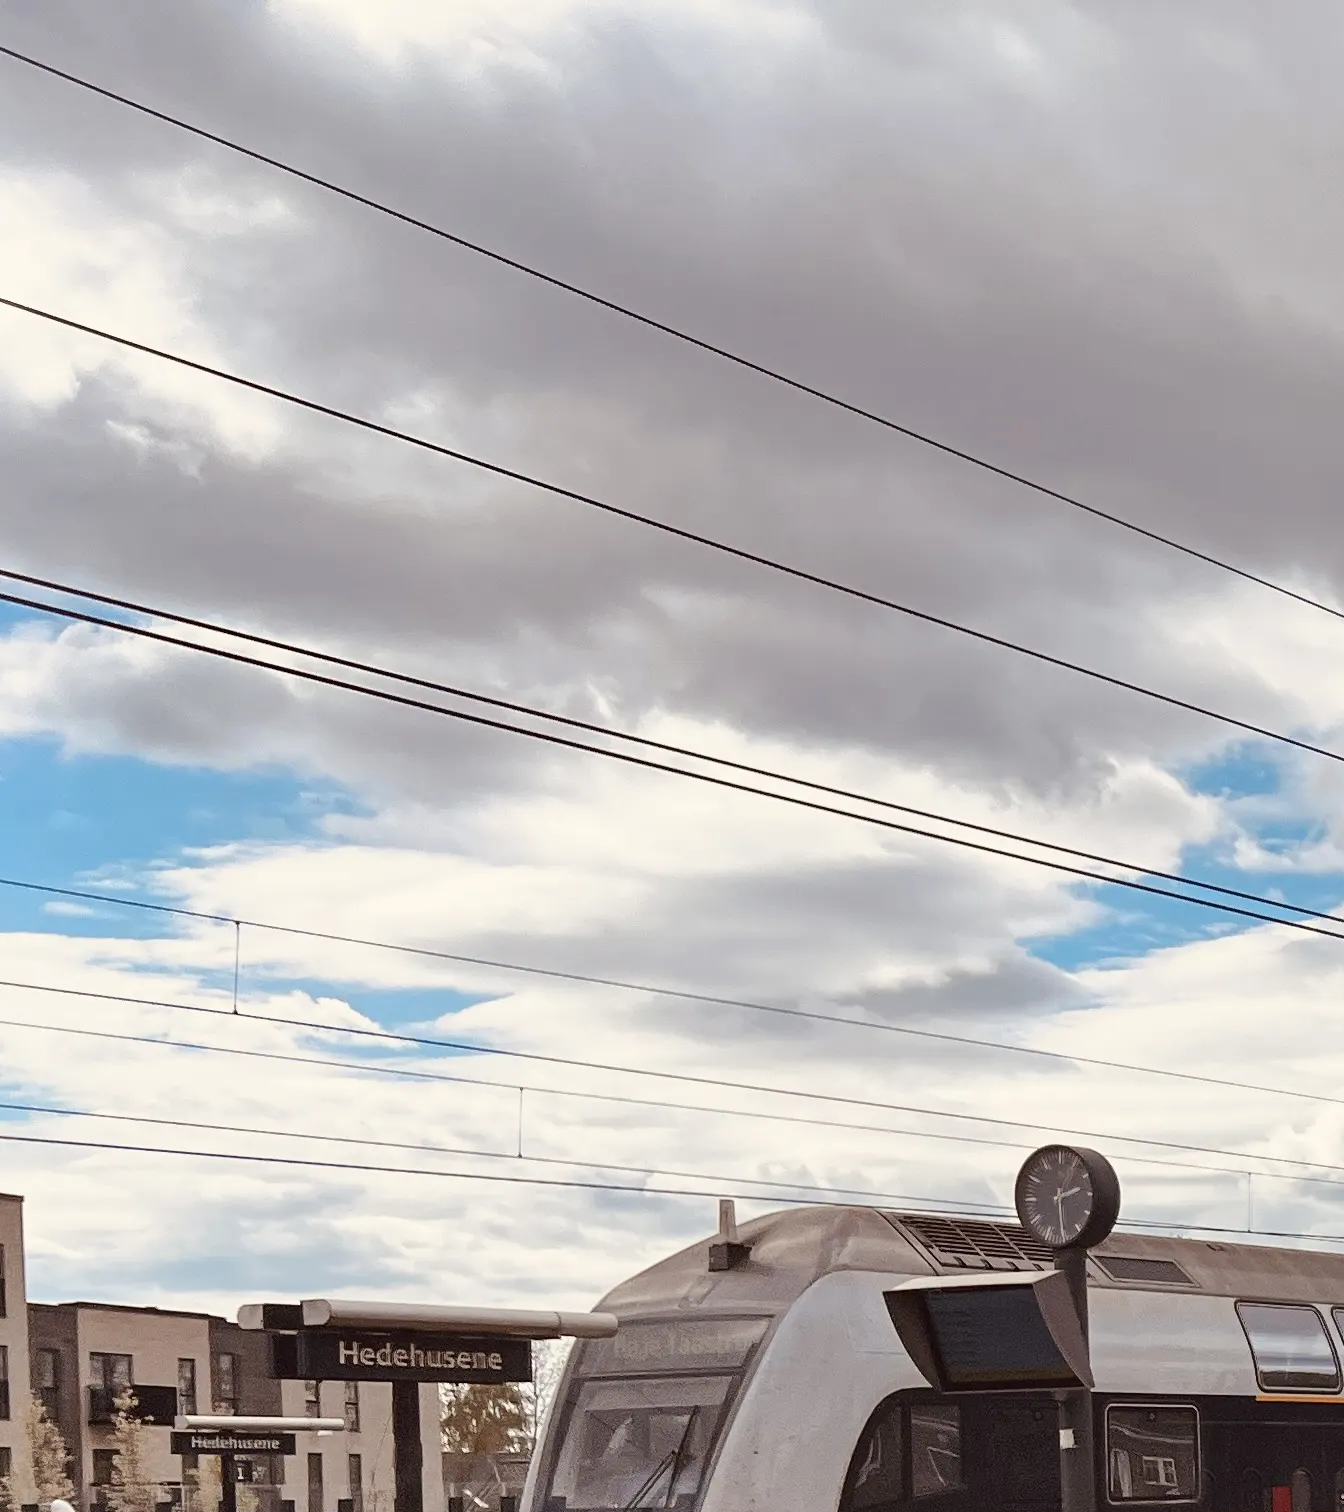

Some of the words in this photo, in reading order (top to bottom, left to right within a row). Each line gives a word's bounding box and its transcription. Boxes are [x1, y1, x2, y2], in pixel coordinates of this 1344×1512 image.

[338, 1340, 503, 1371] Hedehusene
[190, 1435, 281, 1450] Hedehusene
[237, 1467, 245, 1480] 1
